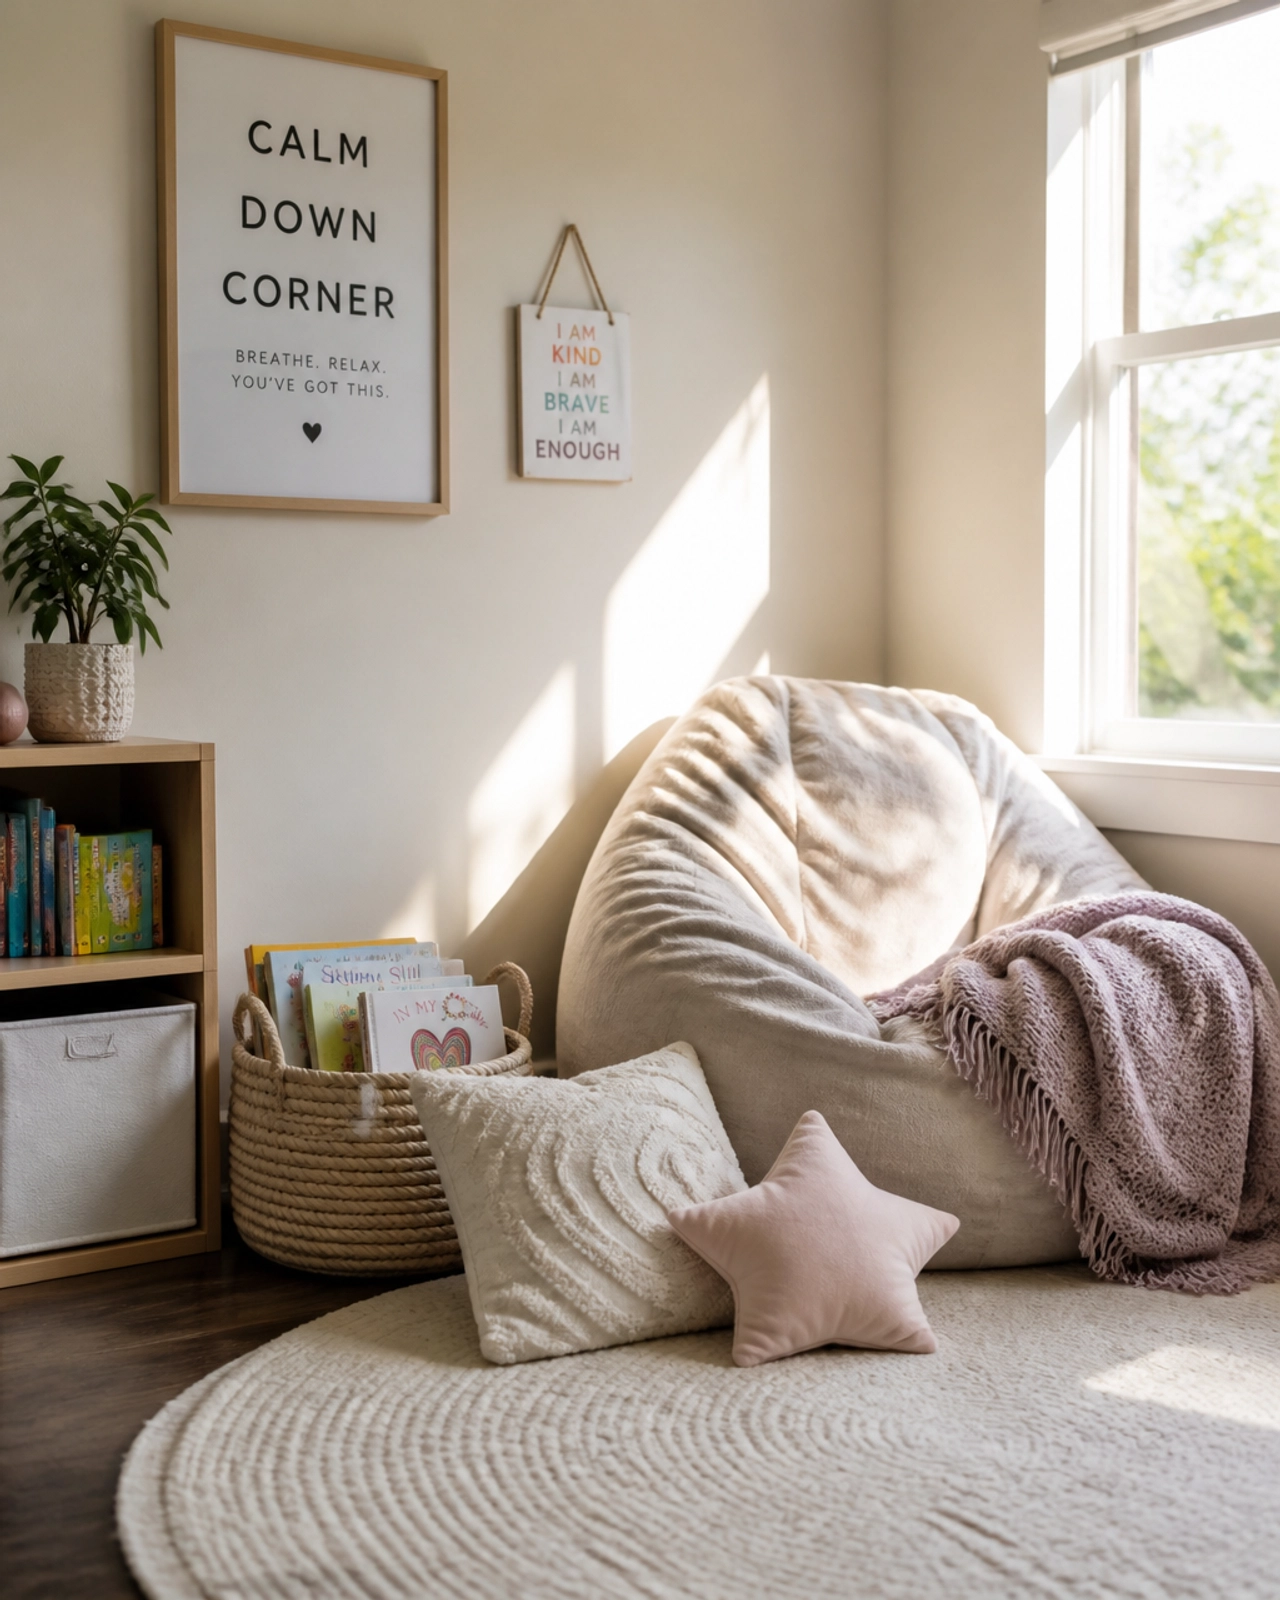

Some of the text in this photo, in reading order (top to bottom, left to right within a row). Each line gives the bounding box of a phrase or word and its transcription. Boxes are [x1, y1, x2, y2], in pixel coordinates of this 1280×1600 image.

[248, 119, 368, 168] CALM
[241, 195, 376, 243] DOWN
[222, 271, 395, 319] CORNER
[557, 323, 596, 341] I AM
[235, 349, 387, 374] BREATHE. RELAX.
[552, 345, 602, 366] KIND
[231, 374, 389, 399] YOU'VE GOT THIS.
[557, 371, 596, 388] I AM
[544, 392, 609, 414] BRAVE
[558, 419, 597, 436] I AM
[535, 439, 620, 461] ENOUGH
[415, 1000, 436, 1014] MY
